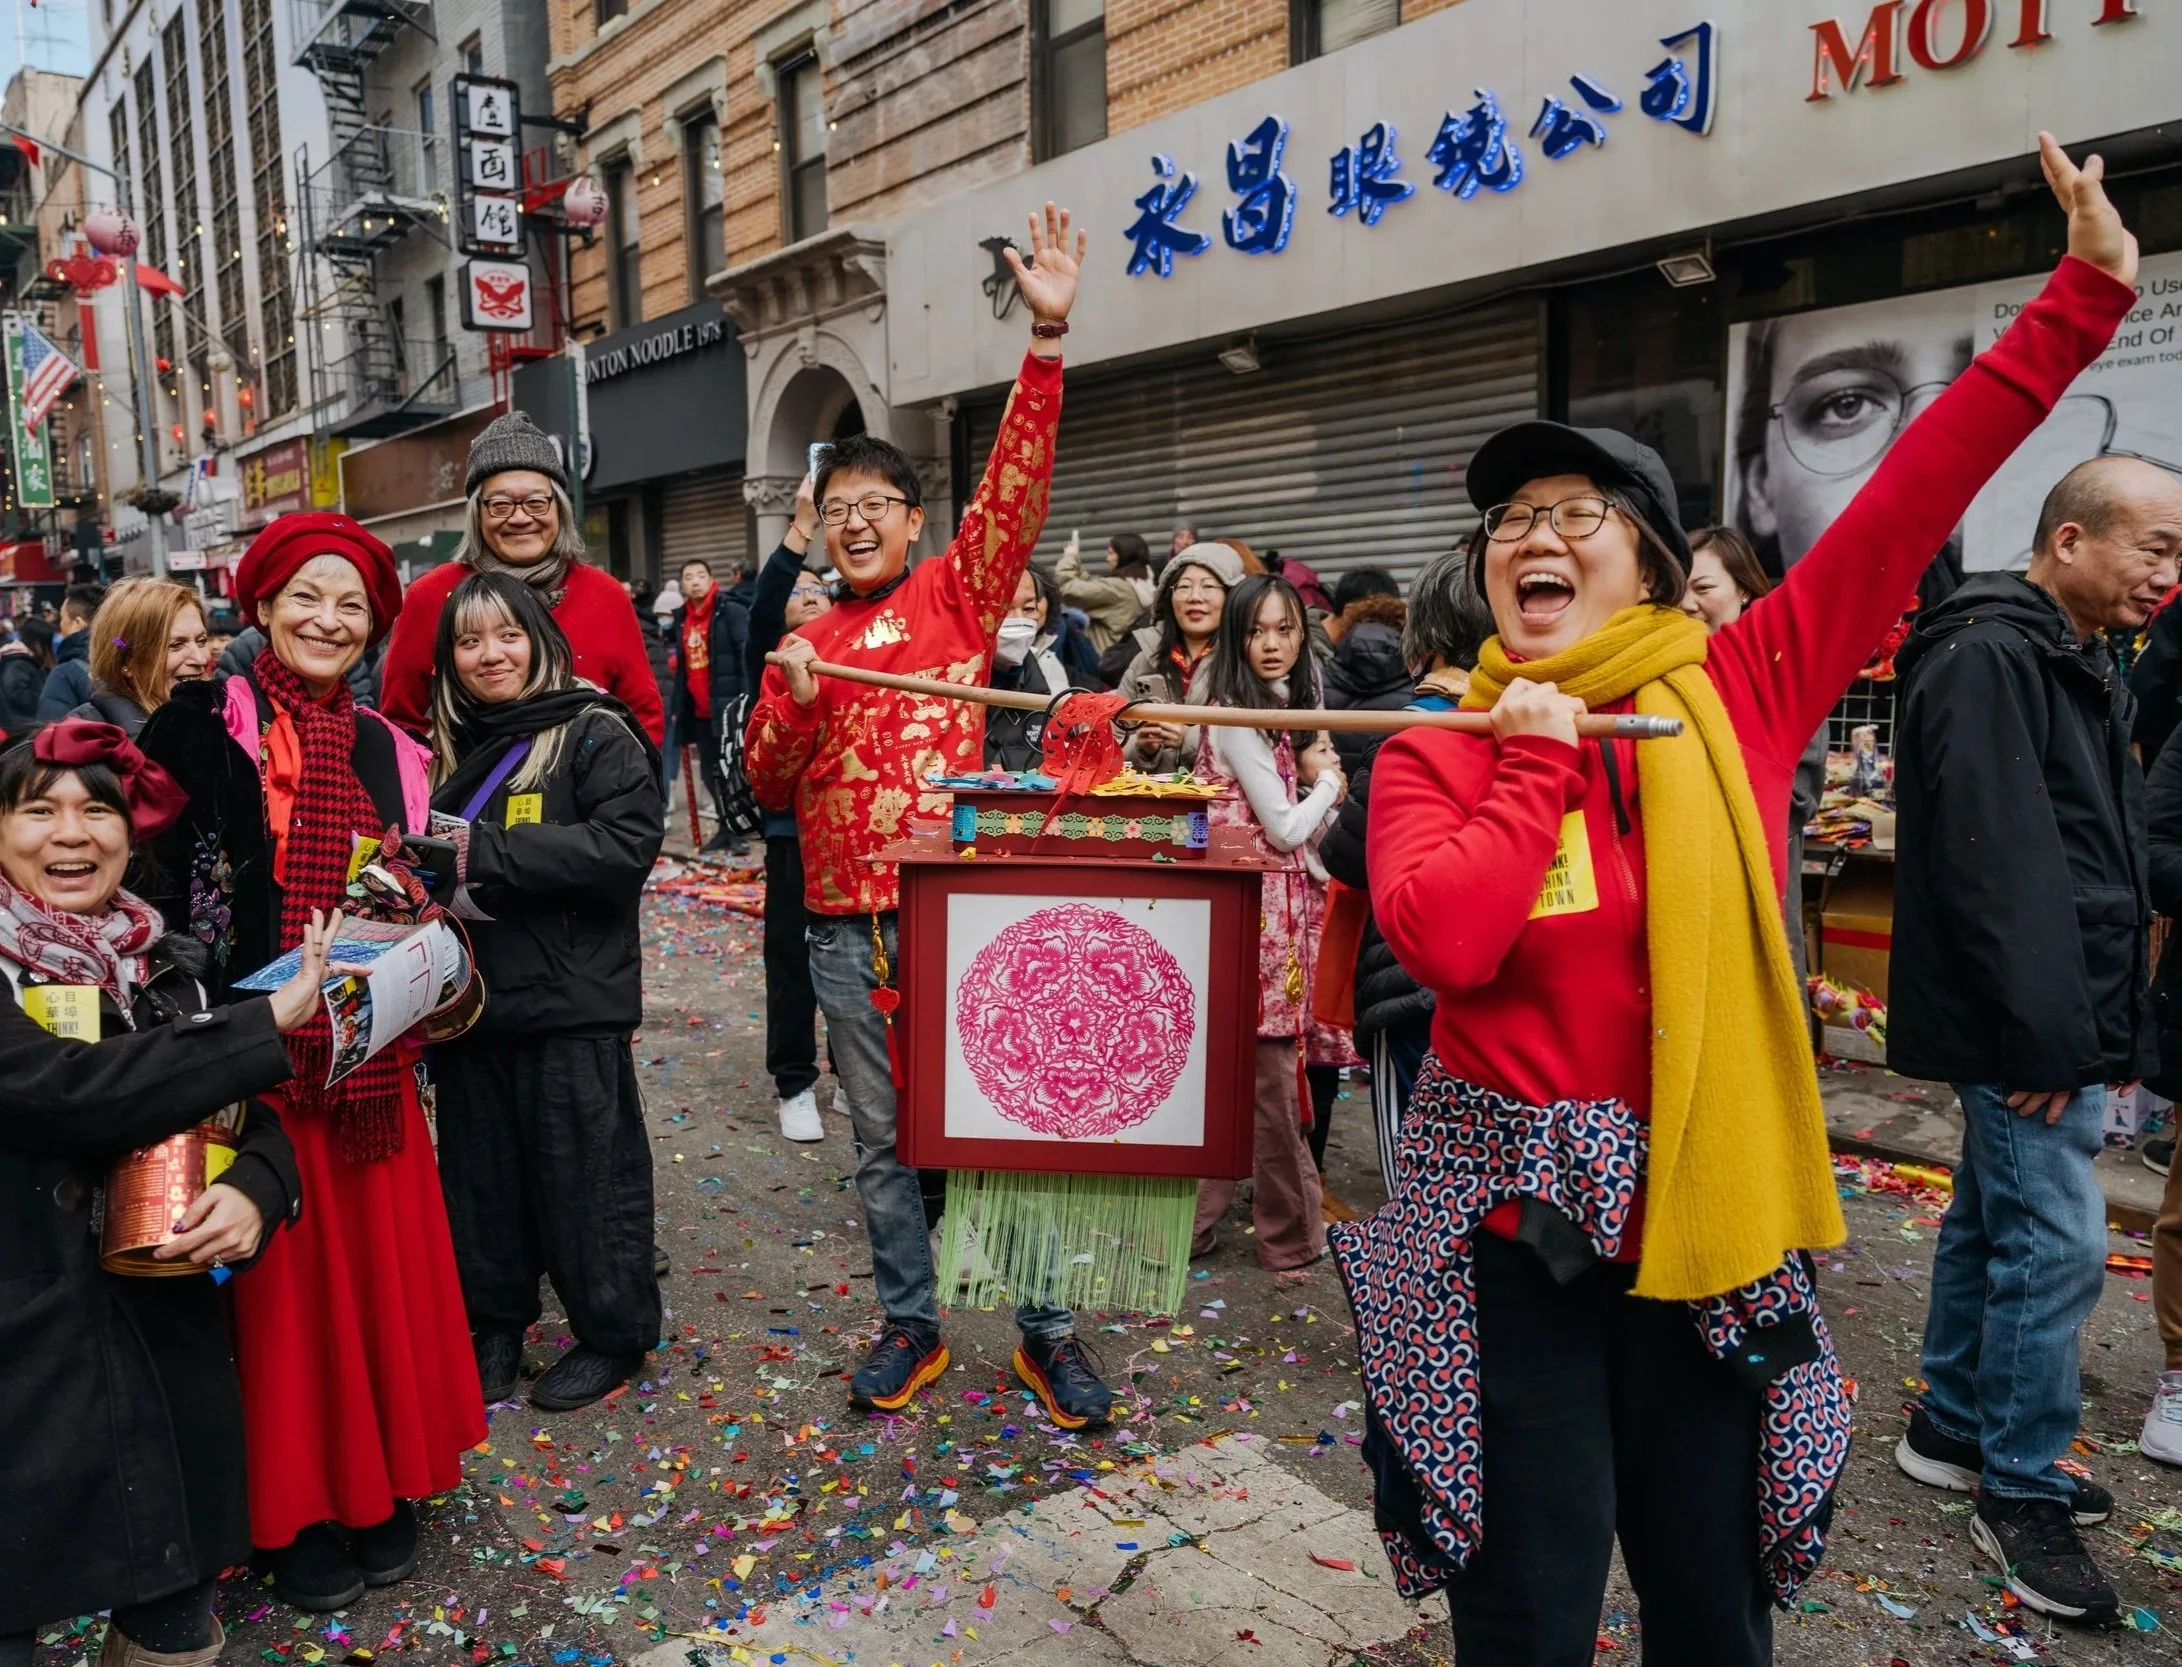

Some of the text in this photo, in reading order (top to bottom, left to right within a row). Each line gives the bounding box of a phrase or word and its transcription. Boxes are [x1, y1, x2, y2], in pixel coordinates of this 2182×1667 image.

[1123, 19, 1718, 278] 永昌眼鏡公司
[2150, 326, 2175, 345] Of
[629, 324, 694, 369] NOODLE
[2118, 354, 2156, 368] exam
[1541, 871, 1572, 891] HINA
[1540, 889, 1575, 908] TOWN
[46, 1021, 79, 1036] THINK!
